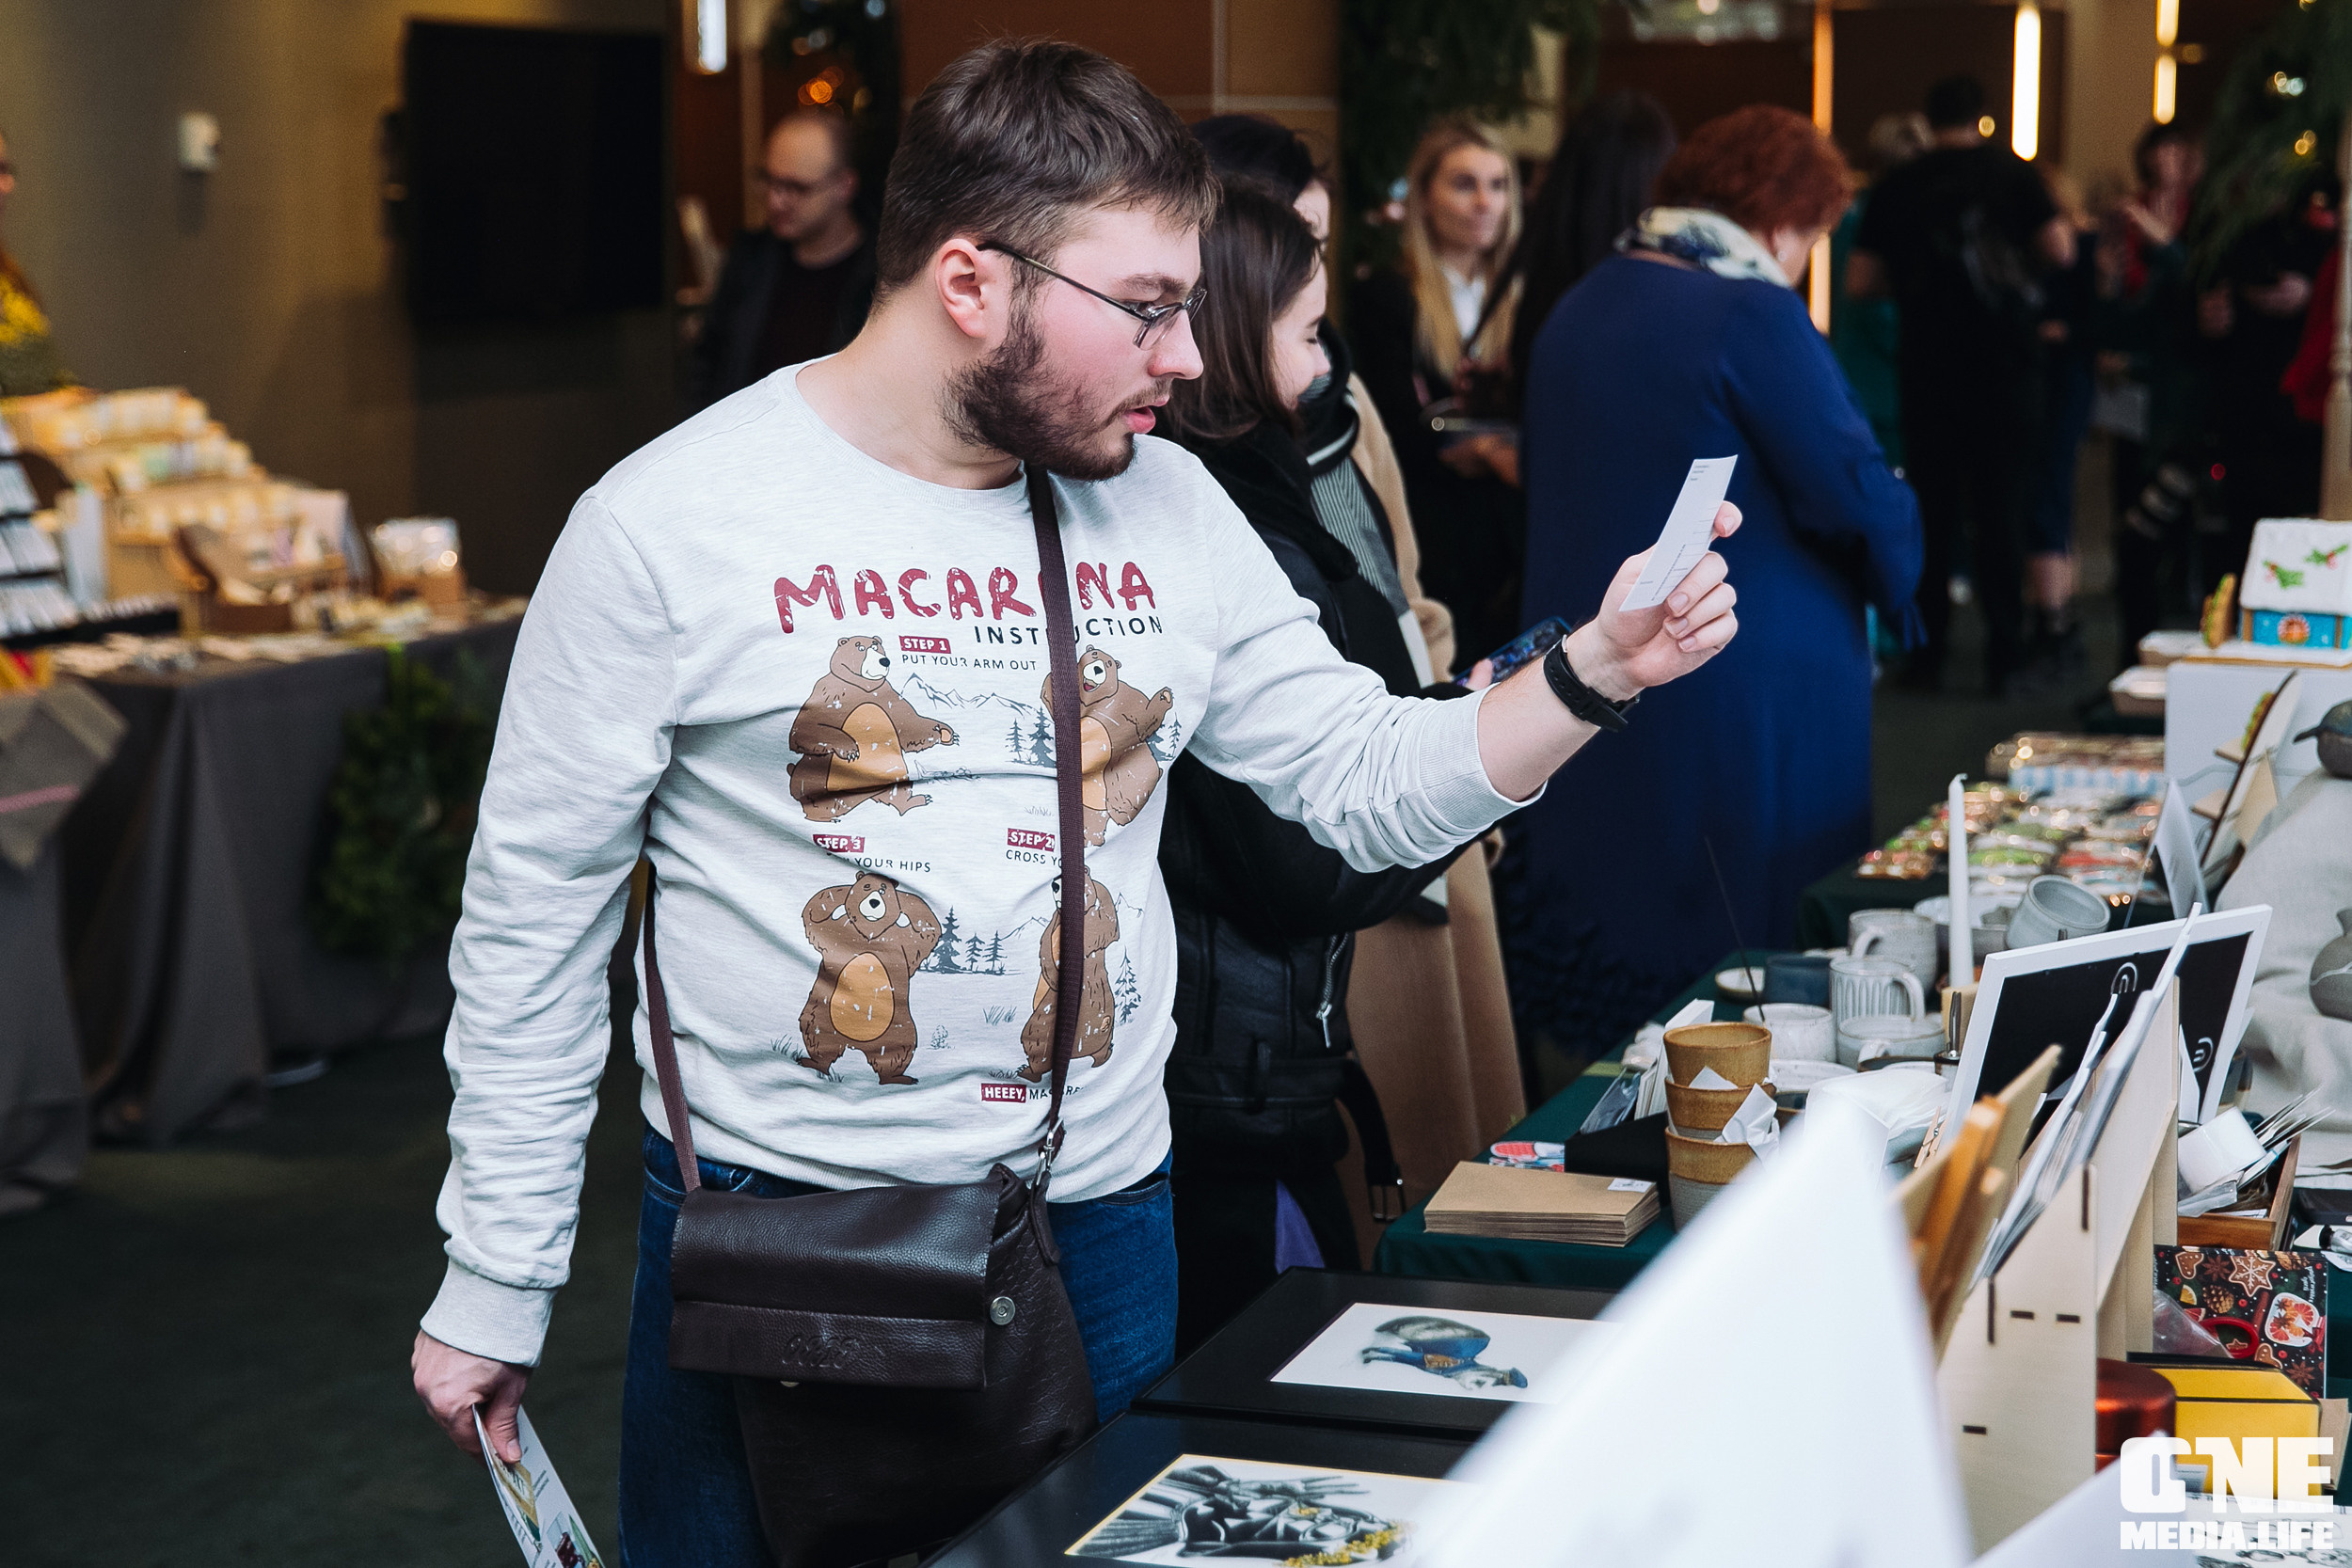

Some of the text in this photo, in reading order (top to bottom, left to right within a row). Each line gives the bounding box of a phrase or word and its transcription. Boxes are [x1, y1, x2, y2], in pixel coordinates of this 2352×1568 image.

[773, 562, 1156, 634] MACARNA
[974, 615, 1164, 645] INSTCTION
[904, 638, 947, 651] STEP 1
[902, 654, 1037, 671] PUT YOUR ARM OUT
[817, 837, 862, 850] STEP 3
[1009, 832, 1041, 846] STEP
[1006, 849, 1046, 864] CROSS
[854, 857, 931, 873] YOUR HIPS
[984, 1086, 1025, 1101] HEEEY,
